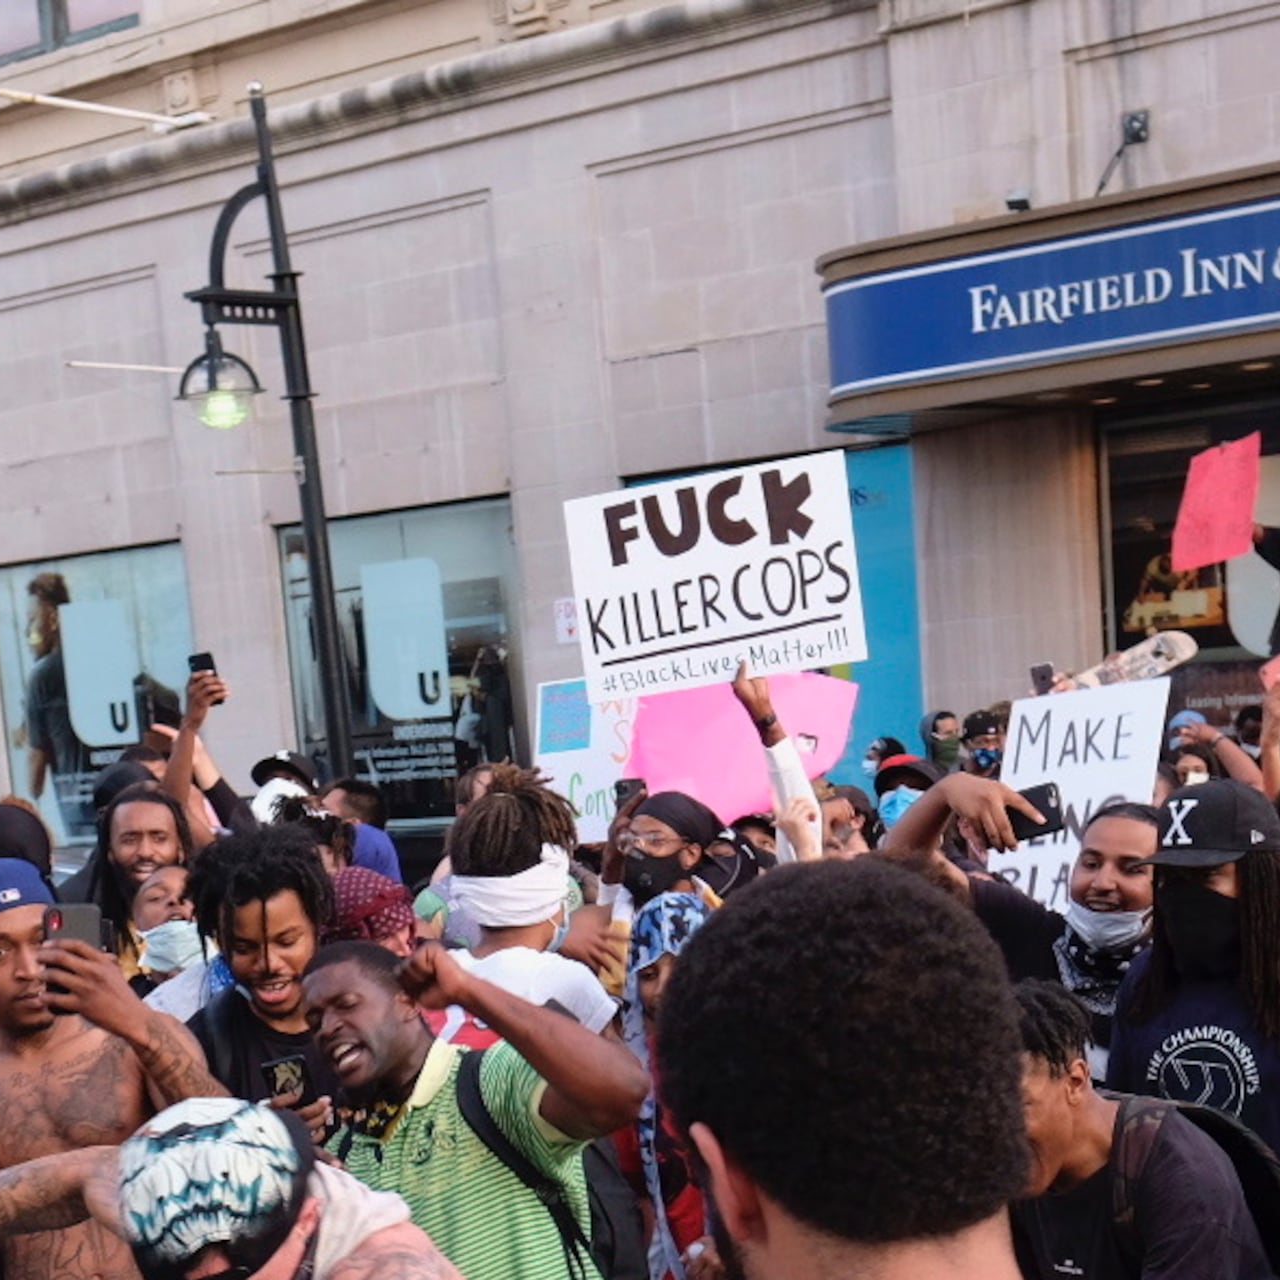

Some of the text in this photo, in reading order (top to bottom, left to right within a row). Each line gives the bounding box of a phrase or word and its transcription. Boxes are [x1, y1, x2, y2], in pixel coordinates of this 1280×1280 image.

[968, 267, 1173, 334] FAIRFIELD
[1179, 246, 1265, 299] INN
[602, 468, 815, 567] FUCK
[585, 540, 852, 655] KILLER COPS
[109, 701, 129, 733] U
[417, 669, 441, 705] U
[1013, 708, 1133, 775] MAKE
[1162, 798, 1200, 848] X
[1146, 1025, 1261, 1096] THE CHAMPIONSHIPS
